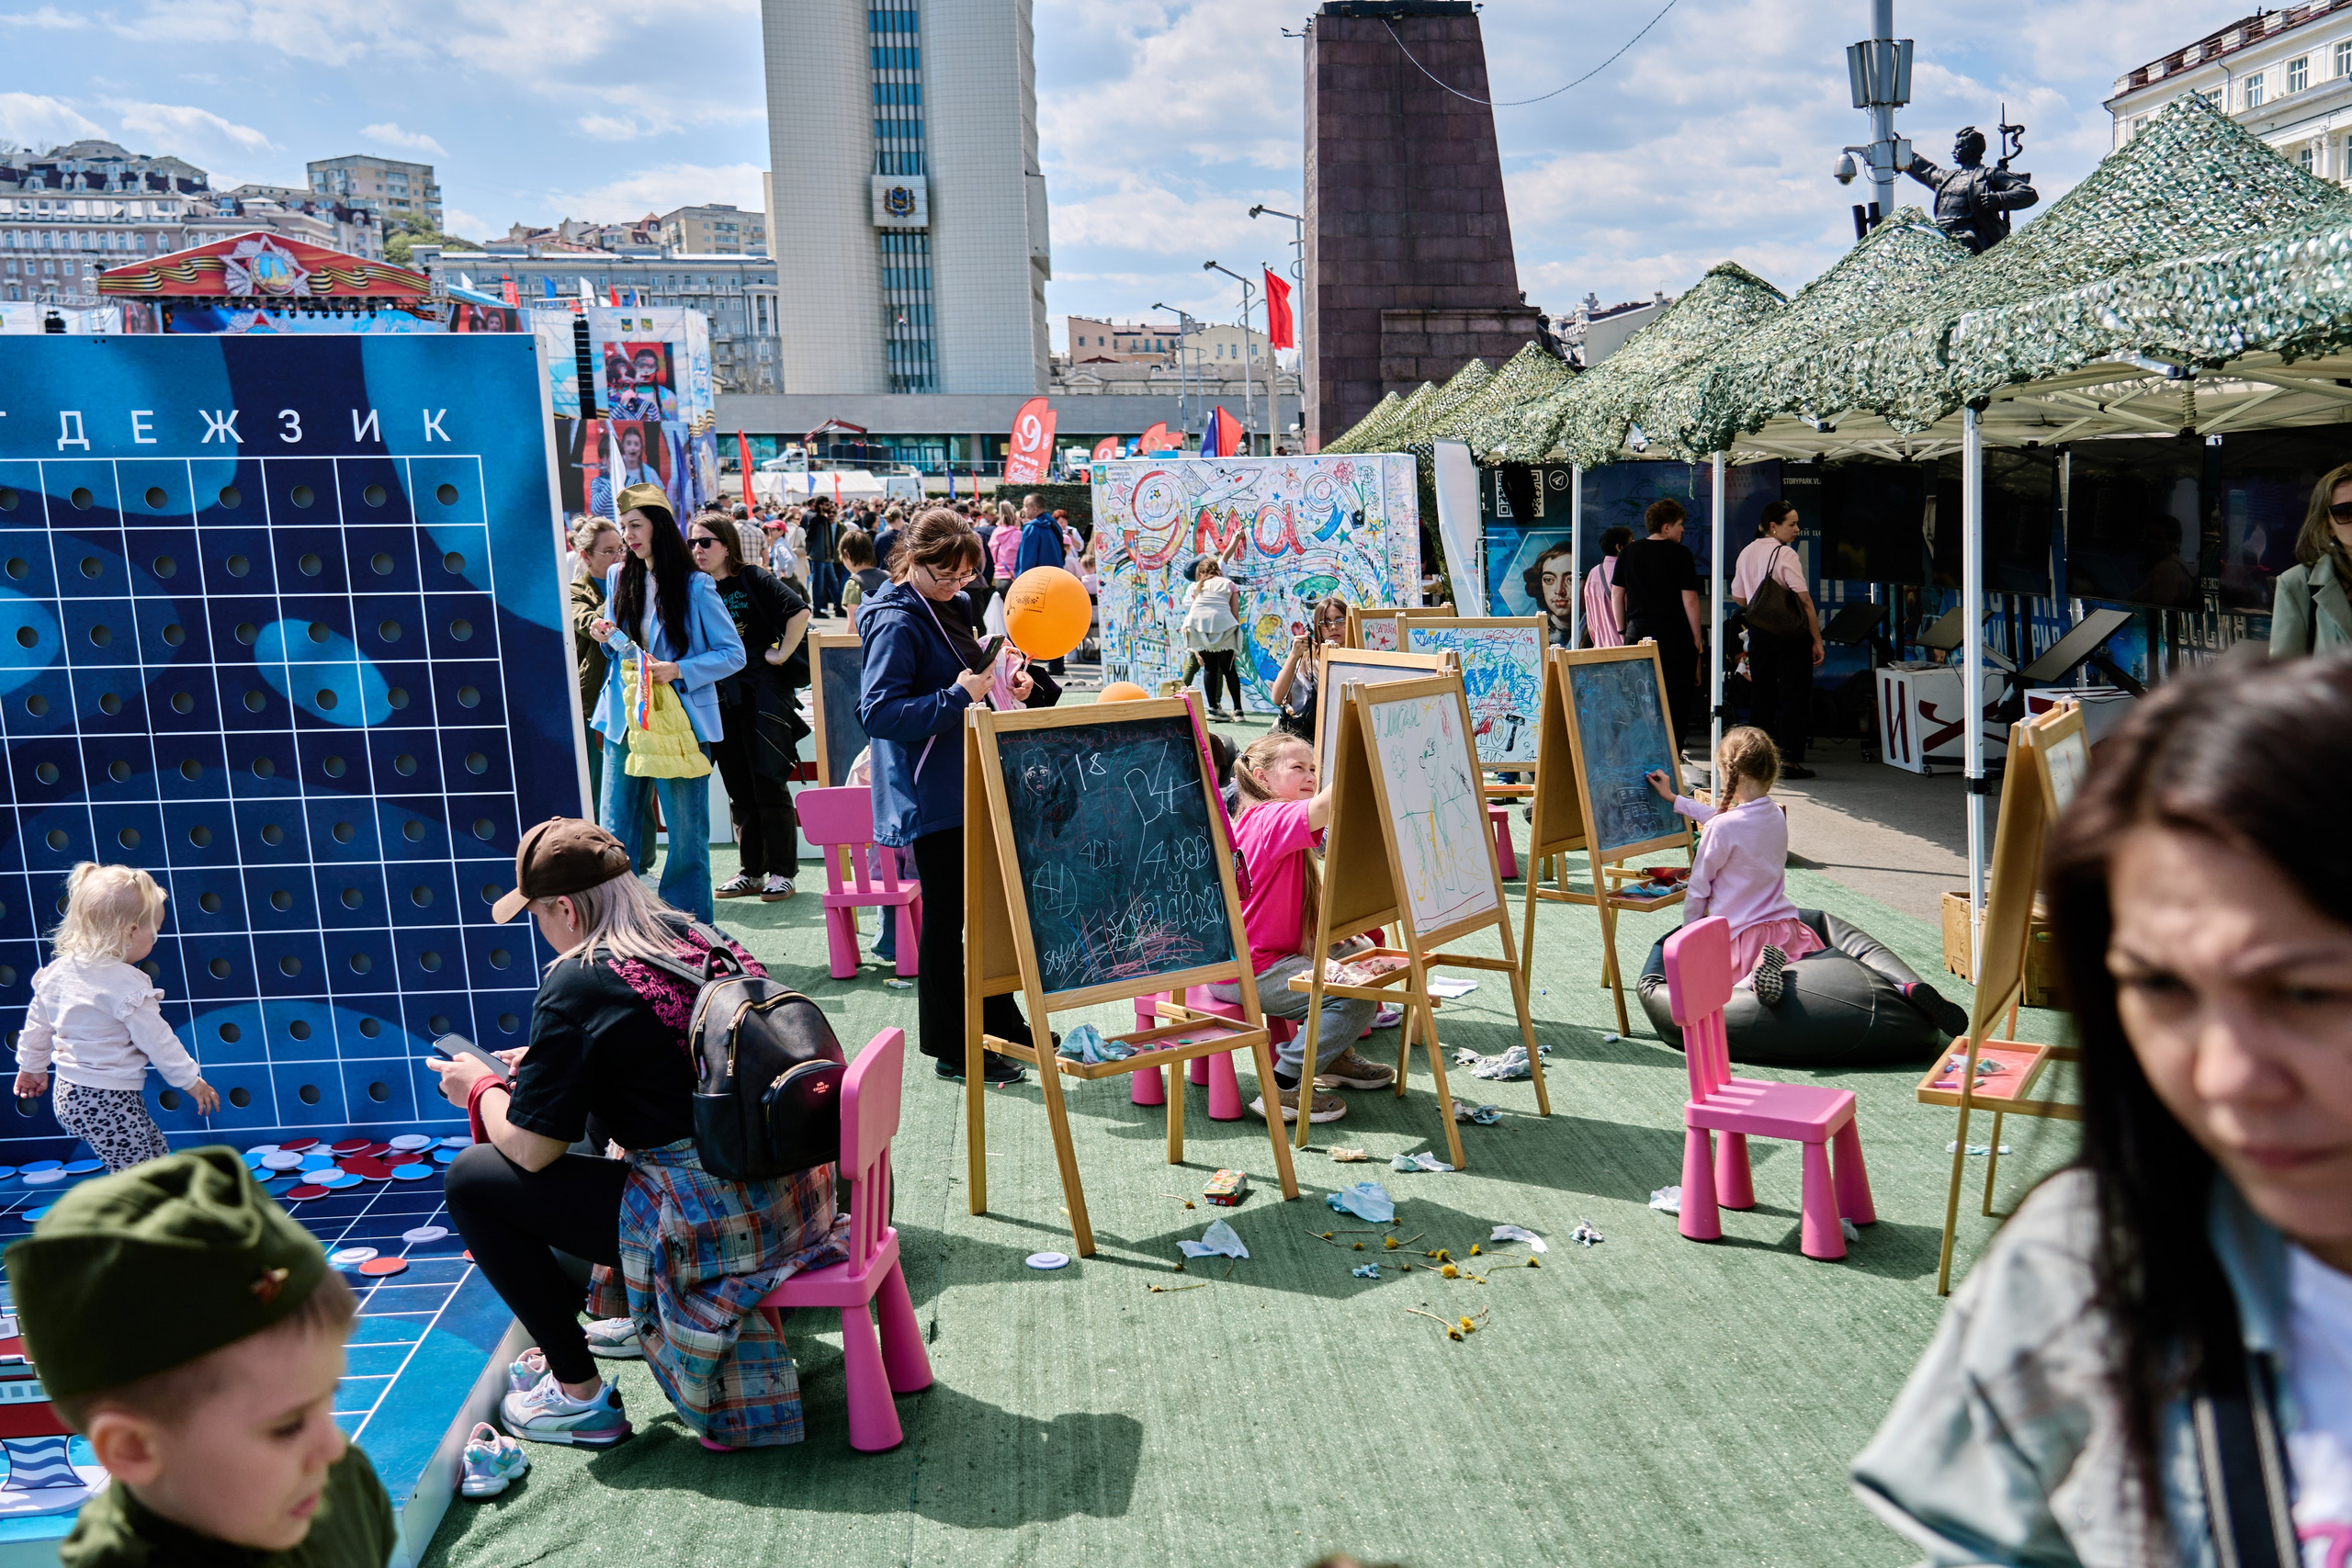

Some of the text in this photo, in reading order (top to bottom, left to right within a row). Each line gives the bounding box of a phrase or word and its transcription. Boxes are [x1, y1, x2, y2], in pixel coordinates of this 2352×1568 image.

[56, 408, 452, 451] Д Е Ж З И К
[1015, 414, 1042, 453] 9
[1782, 478, 1822, 486] STORYPARK.VL
[1123, 470, 1192, 570] 9
